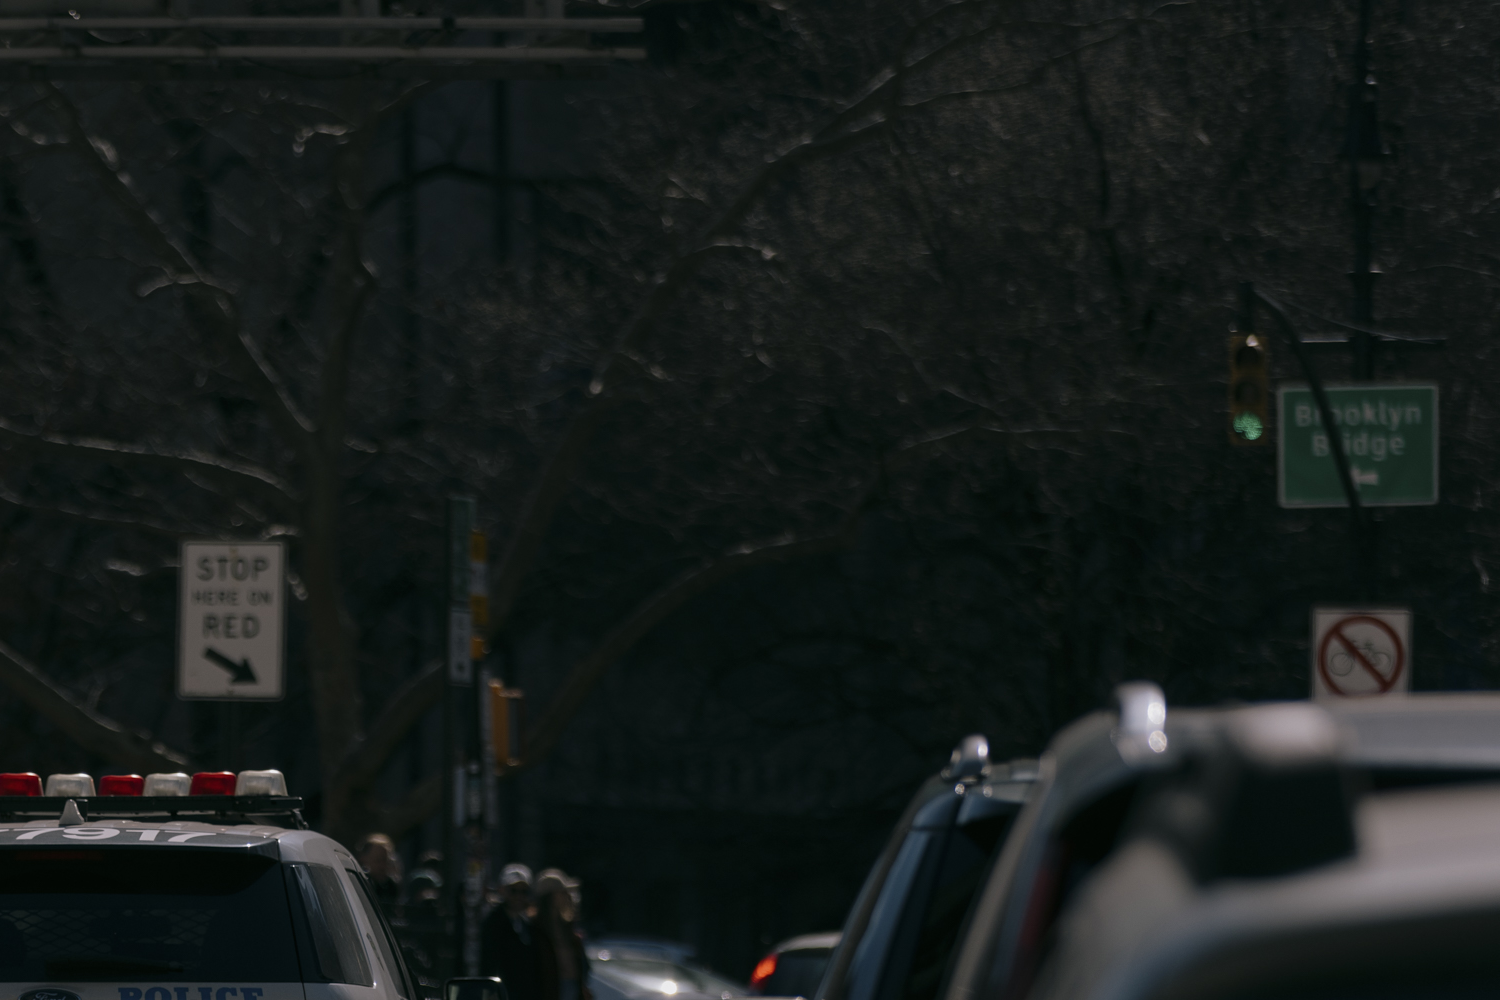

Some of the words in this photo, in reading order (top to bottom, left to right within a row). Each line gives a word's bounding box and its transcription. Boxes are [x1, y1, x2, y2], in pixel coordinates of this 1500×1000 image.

[1312, 432, 1406, 461] Bidge
[197, 557, 268, 581] STOP
[192, 591, 239, 606] HERE
[247, 591, 272, 606] ON
[203, 615, 260, 639] RED
